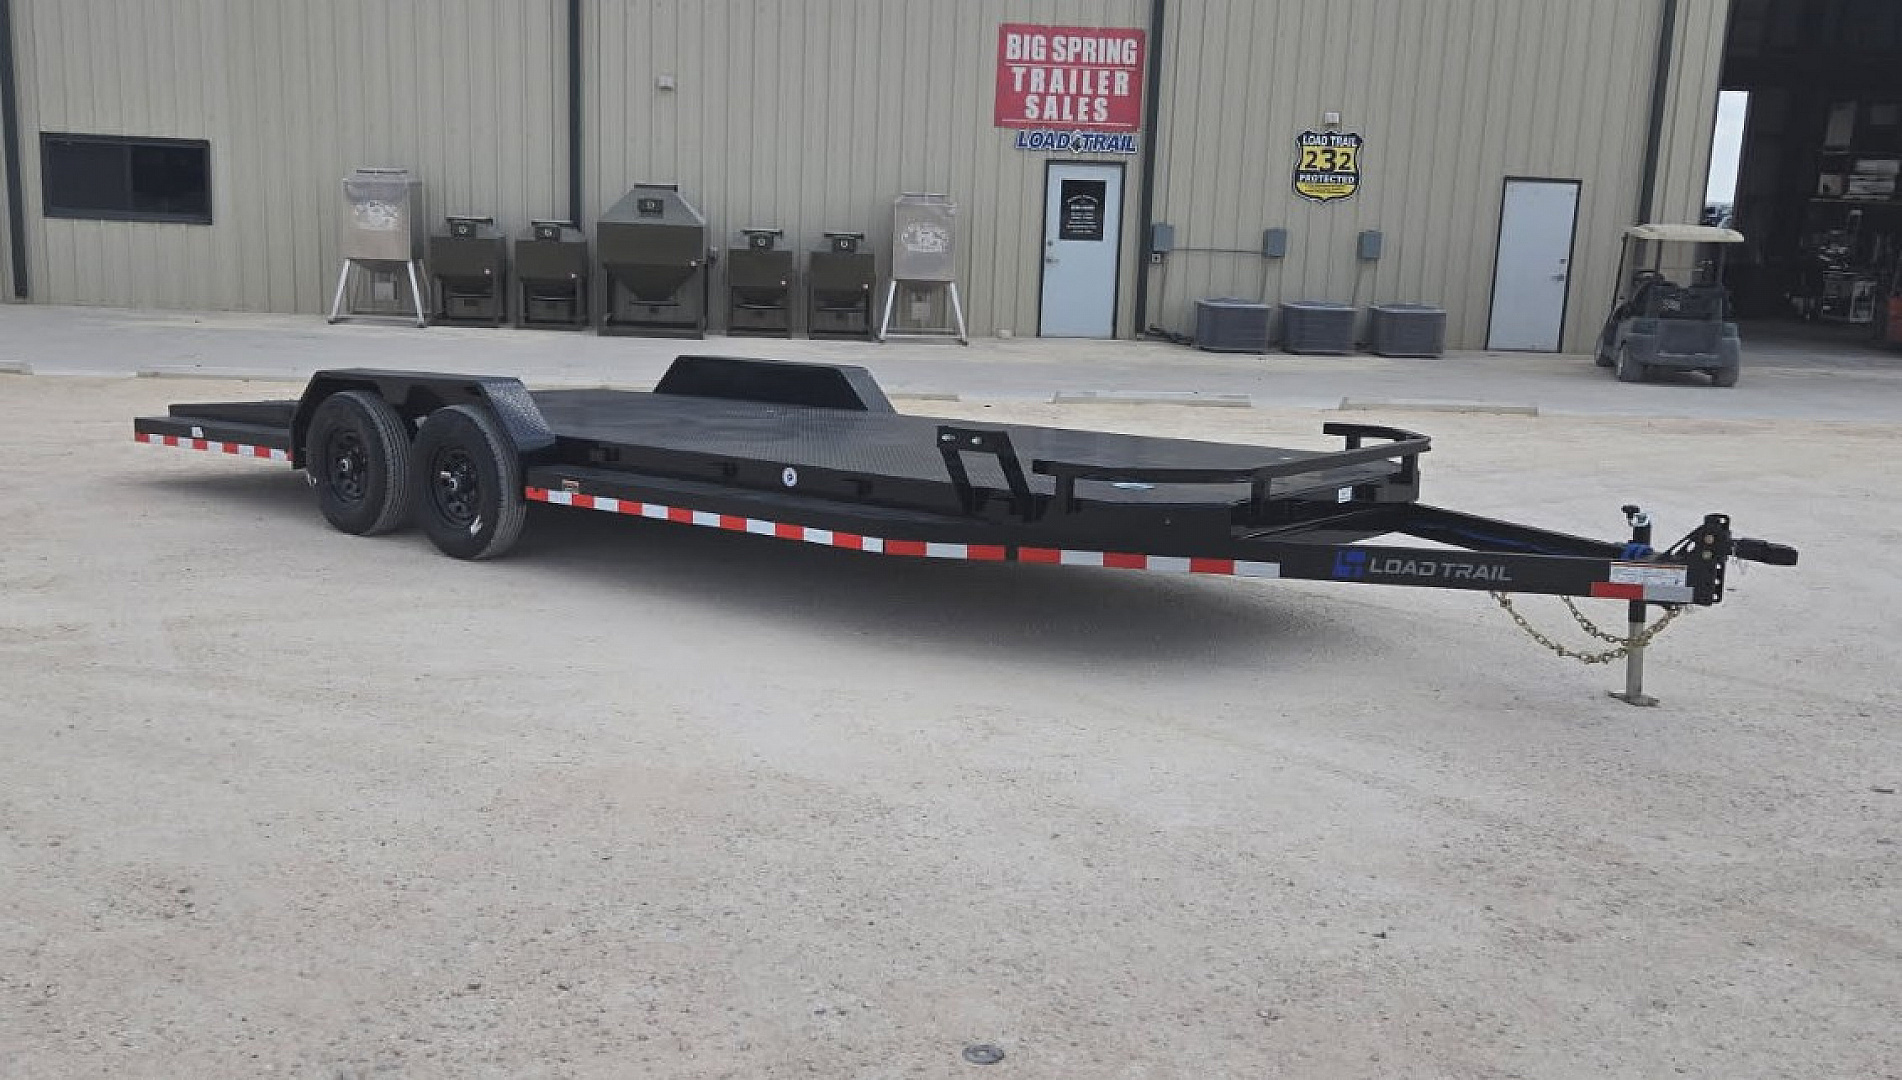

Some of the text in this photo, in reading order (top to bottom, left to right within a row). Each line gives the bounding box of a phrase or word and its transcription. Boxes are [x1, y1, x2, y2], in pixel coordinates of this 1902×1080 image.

[1006, 33, 1138, 65] BIG SPRING
[1012, 66, 1129, 96] TRAILER
[1025, 95, 1109, 122] SALES
[1017, 130, 1137, 153] LOAD TRAIL
[1303, 134, 1328, 146] LOAD
[1304, 149, 1352, 172] 232
[1299, 173, 1355, 185] PROTECTED
[1369, 557, 1513, 581] LOAD TRAIL
